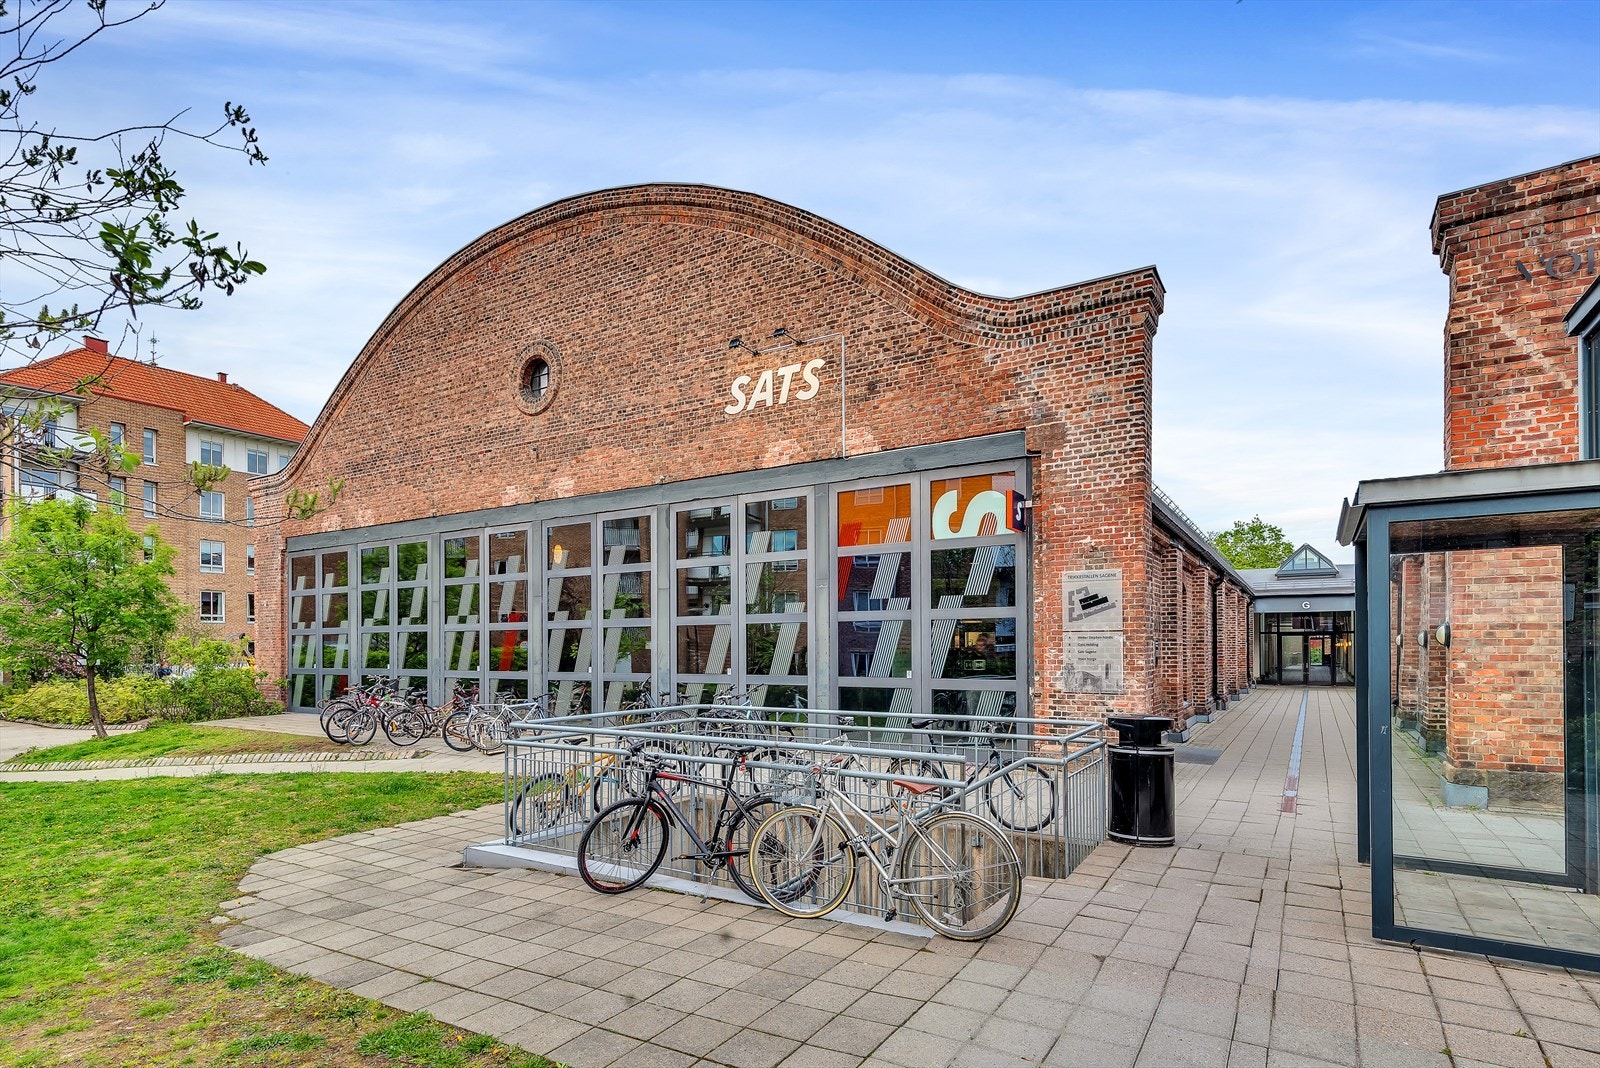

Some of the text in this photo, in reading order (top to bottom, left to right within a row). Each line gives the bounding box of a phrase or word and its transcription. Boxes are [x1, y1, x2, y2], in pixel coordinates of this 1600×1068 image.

[724, 358, 826, 415] SATS
[1015, 501, 1023, 521] S
[1302, 601, 1310, 609] G
